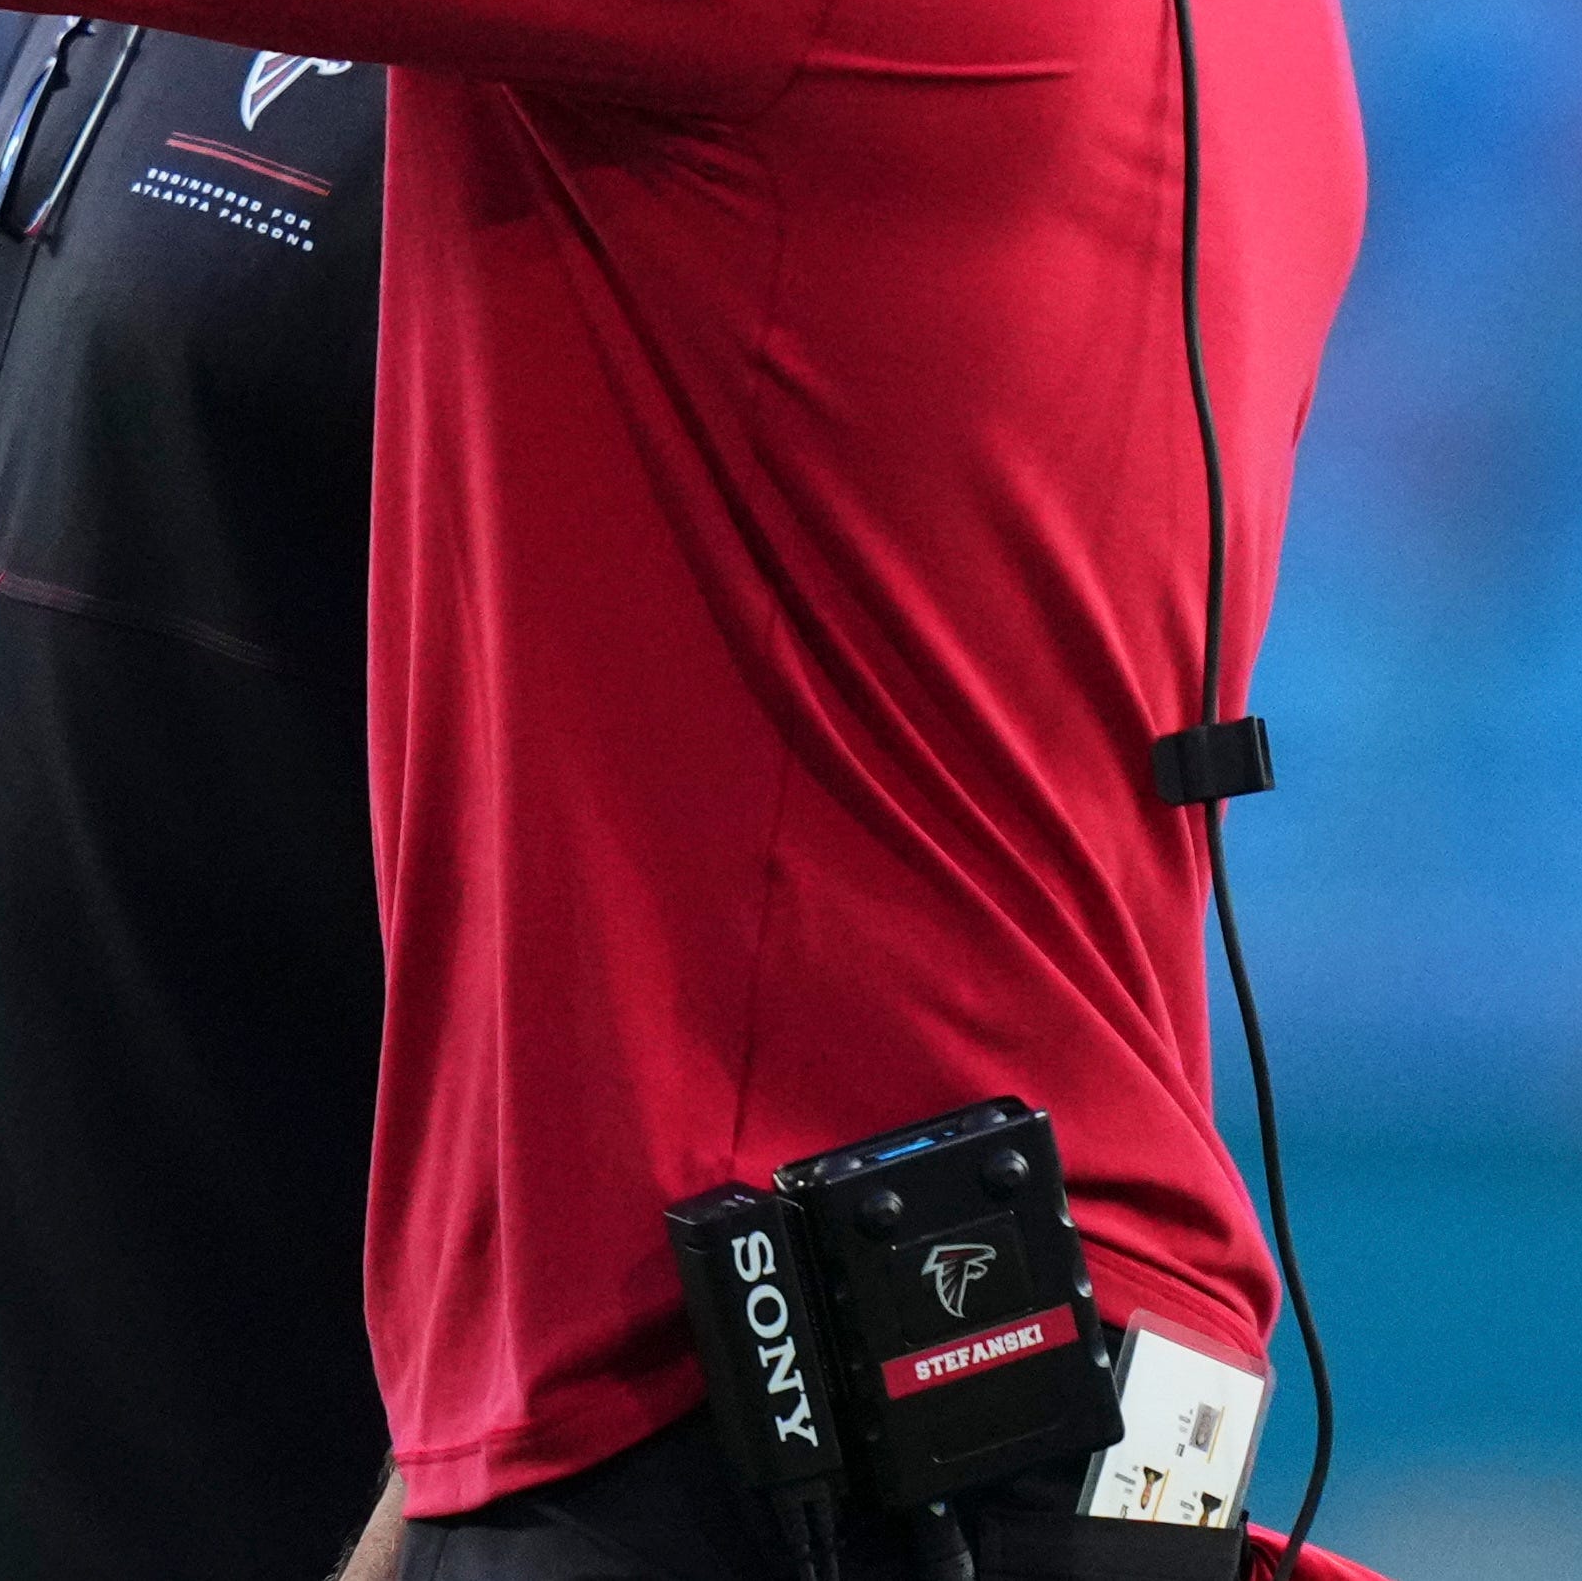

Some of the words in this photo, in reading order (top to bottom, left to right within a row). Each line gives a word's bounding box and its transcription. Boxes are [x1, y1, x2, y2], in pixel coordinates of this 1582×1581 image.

[130, 181, 210, 213] ATLANTA
[218, 207, 315, 253] FALCONS
[146, 167, 263, 213] ENGINEERED
[270, 207, 312, 232] FOR
[730, 1229, 820, 1448] SONY
[914, 1322, 1045, 1382] STEFANSKI
